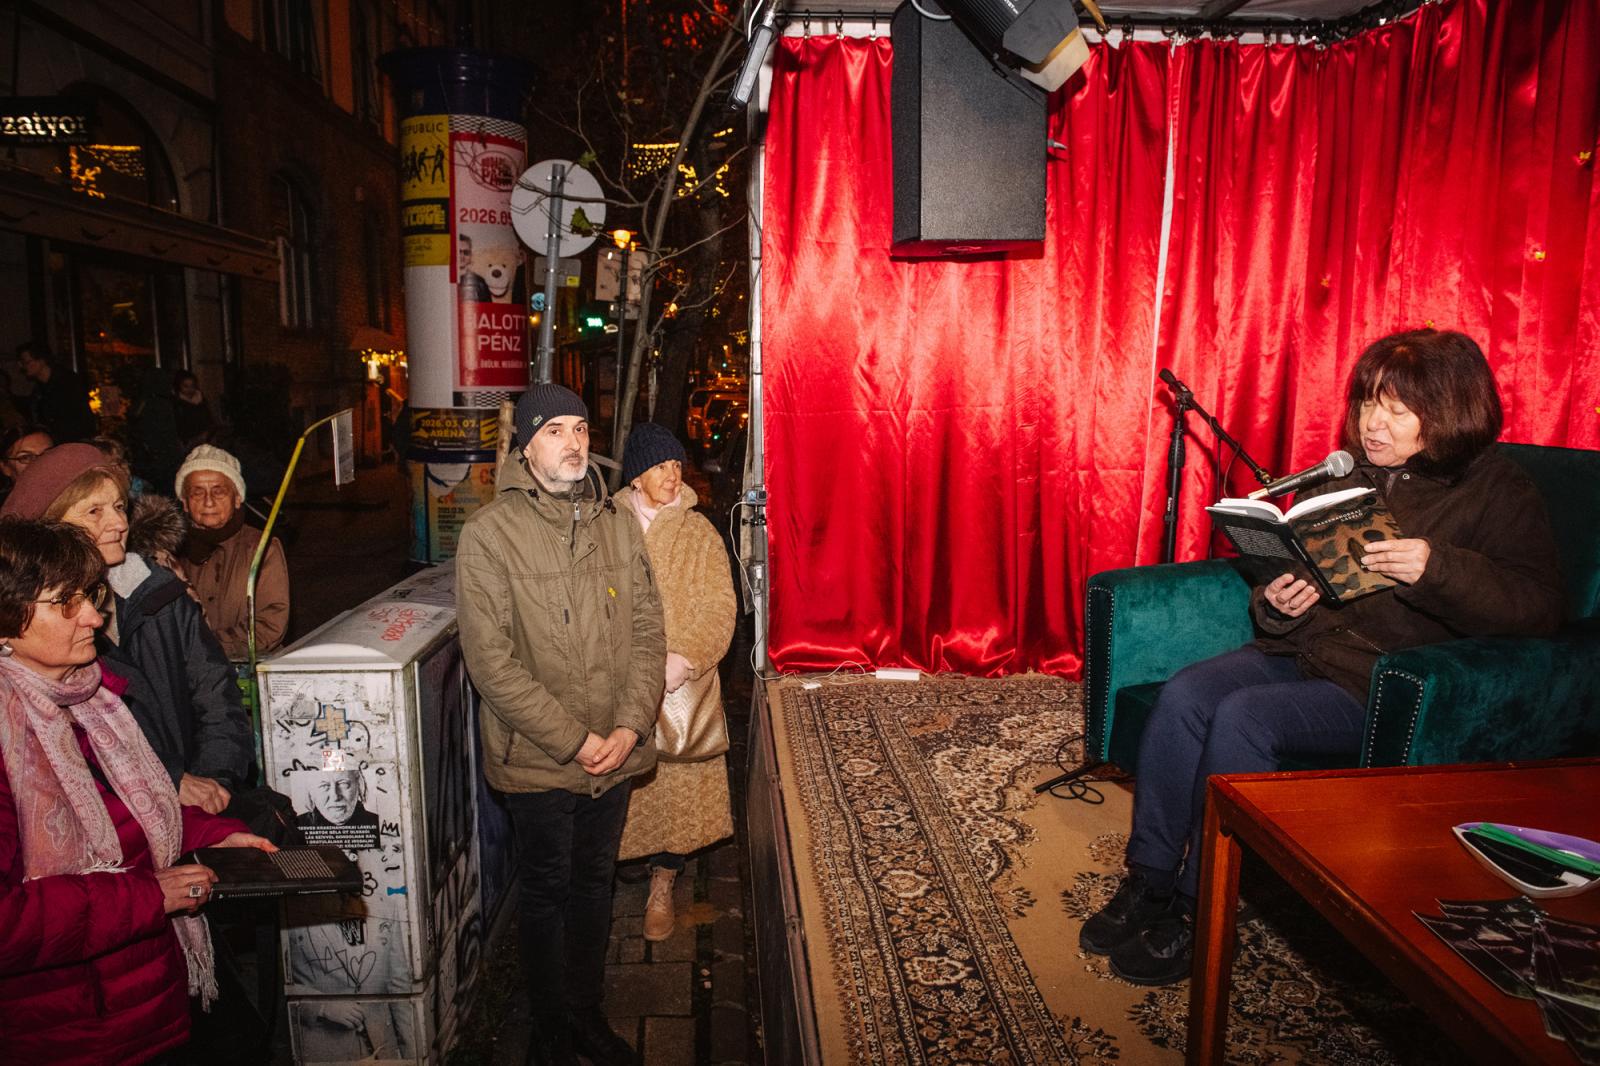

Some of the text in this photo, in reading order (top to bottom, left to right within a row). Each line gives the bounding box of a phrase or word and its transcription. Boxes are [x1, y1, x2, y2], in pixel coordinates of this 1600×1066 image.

[0, 112, 88, 138] zatyor
[400, 122, 443, 136] EPUBLIC
[478, 332, 521, 351] PÉNZ
